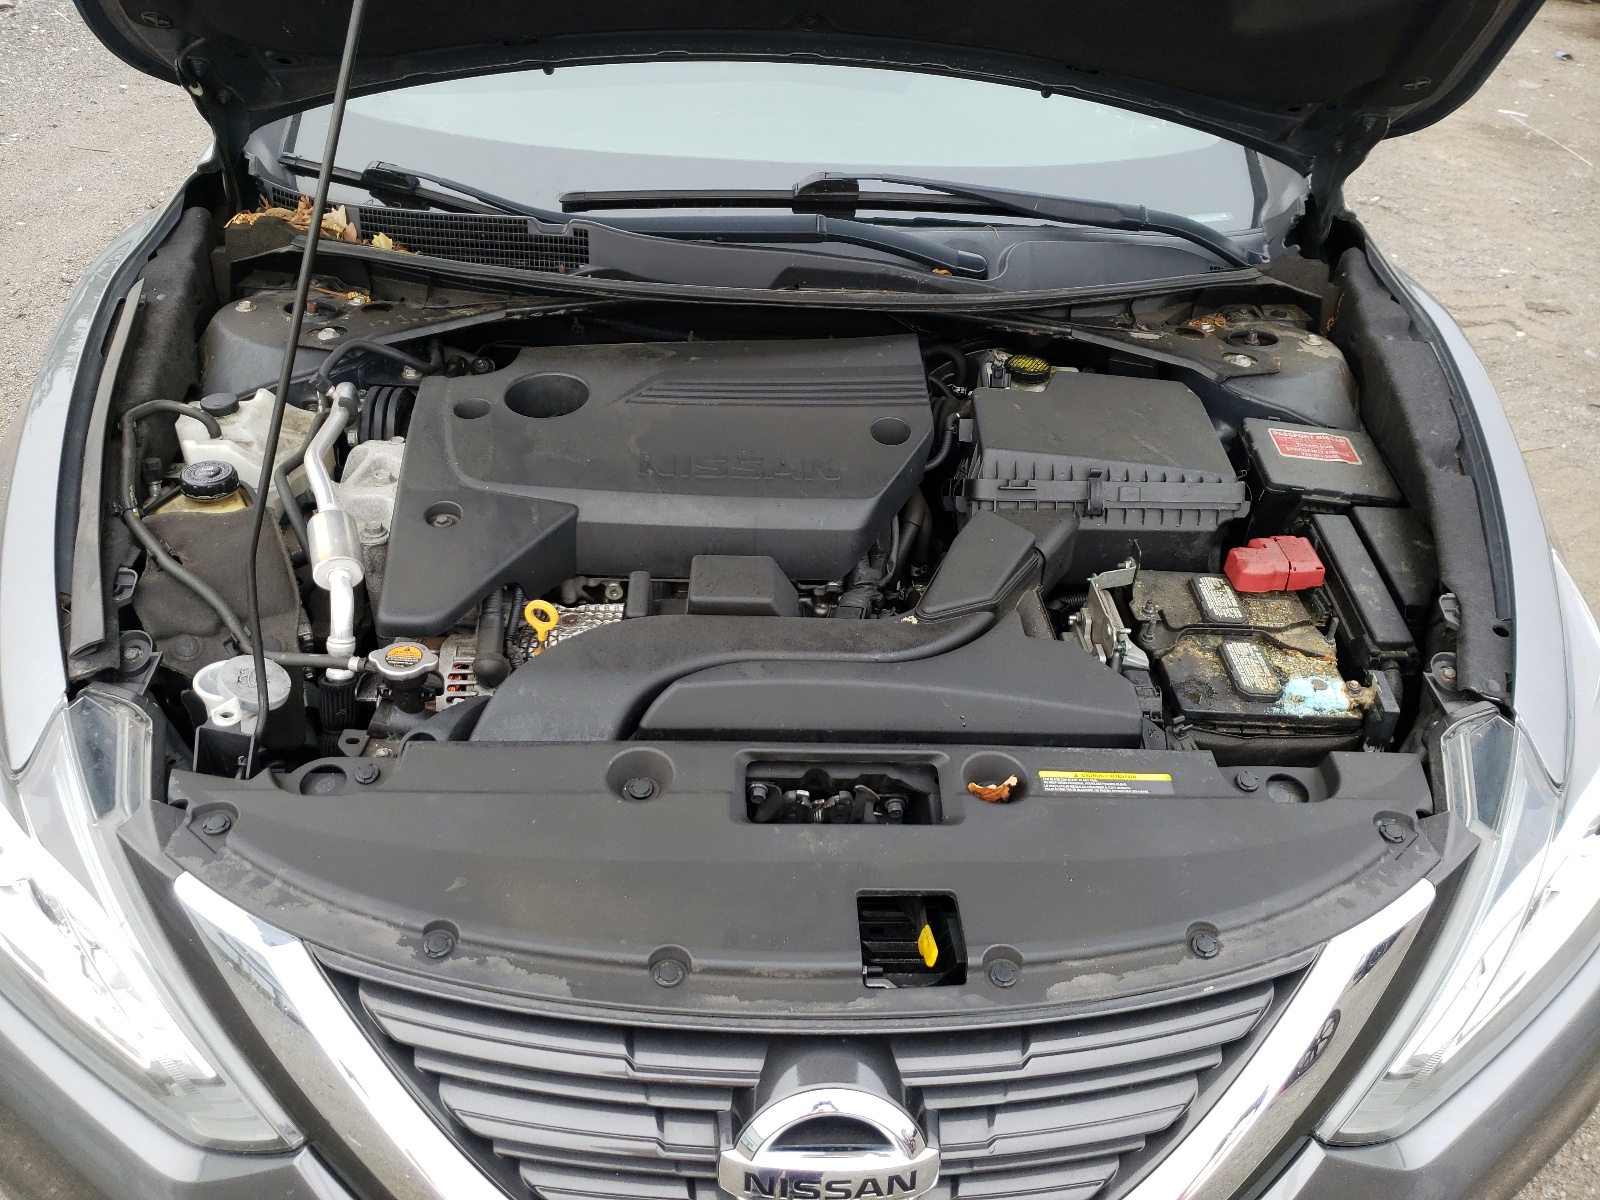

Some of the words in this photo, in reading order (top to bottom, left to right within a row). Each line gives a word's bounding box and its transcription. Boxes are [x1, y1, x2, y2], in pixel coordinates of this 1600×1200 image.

[1272, 430, 1314, 440] PASSPORT
[638, 453, 841, 481] NISSAN
[743, 1170, 918, 1200] NISSAN
